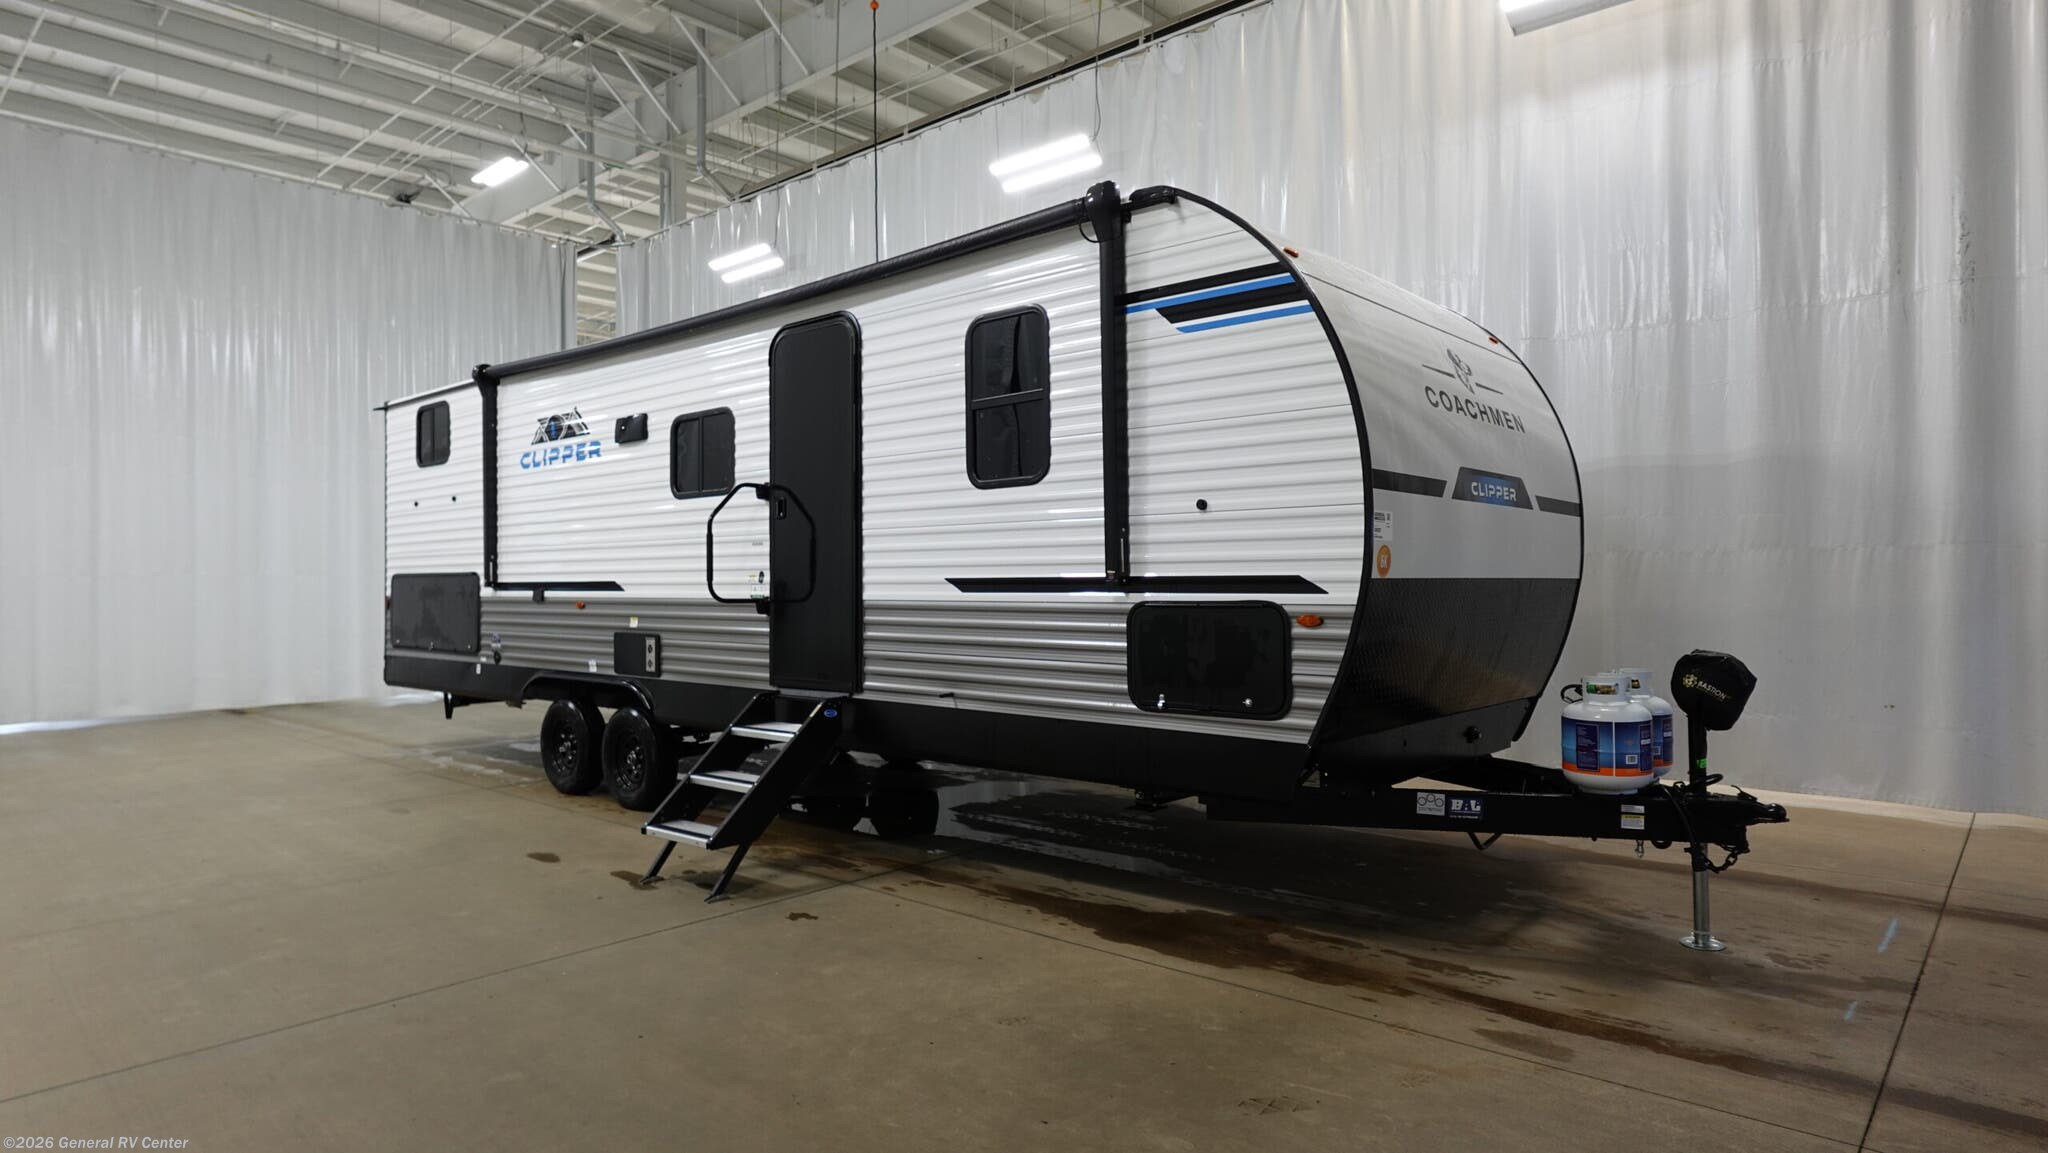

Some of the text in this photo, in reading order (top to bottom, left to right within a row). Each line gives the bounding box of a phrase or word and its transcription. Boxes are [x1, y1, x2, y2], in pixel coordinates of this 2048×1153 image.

[1424, 386, 1526, 434] COACHMEN
[519, 441, 602, 470] CLIPPER
[1471, 481, 1517, 502] CLIPPER
[1697, 680, 1727, 700] BASTION
